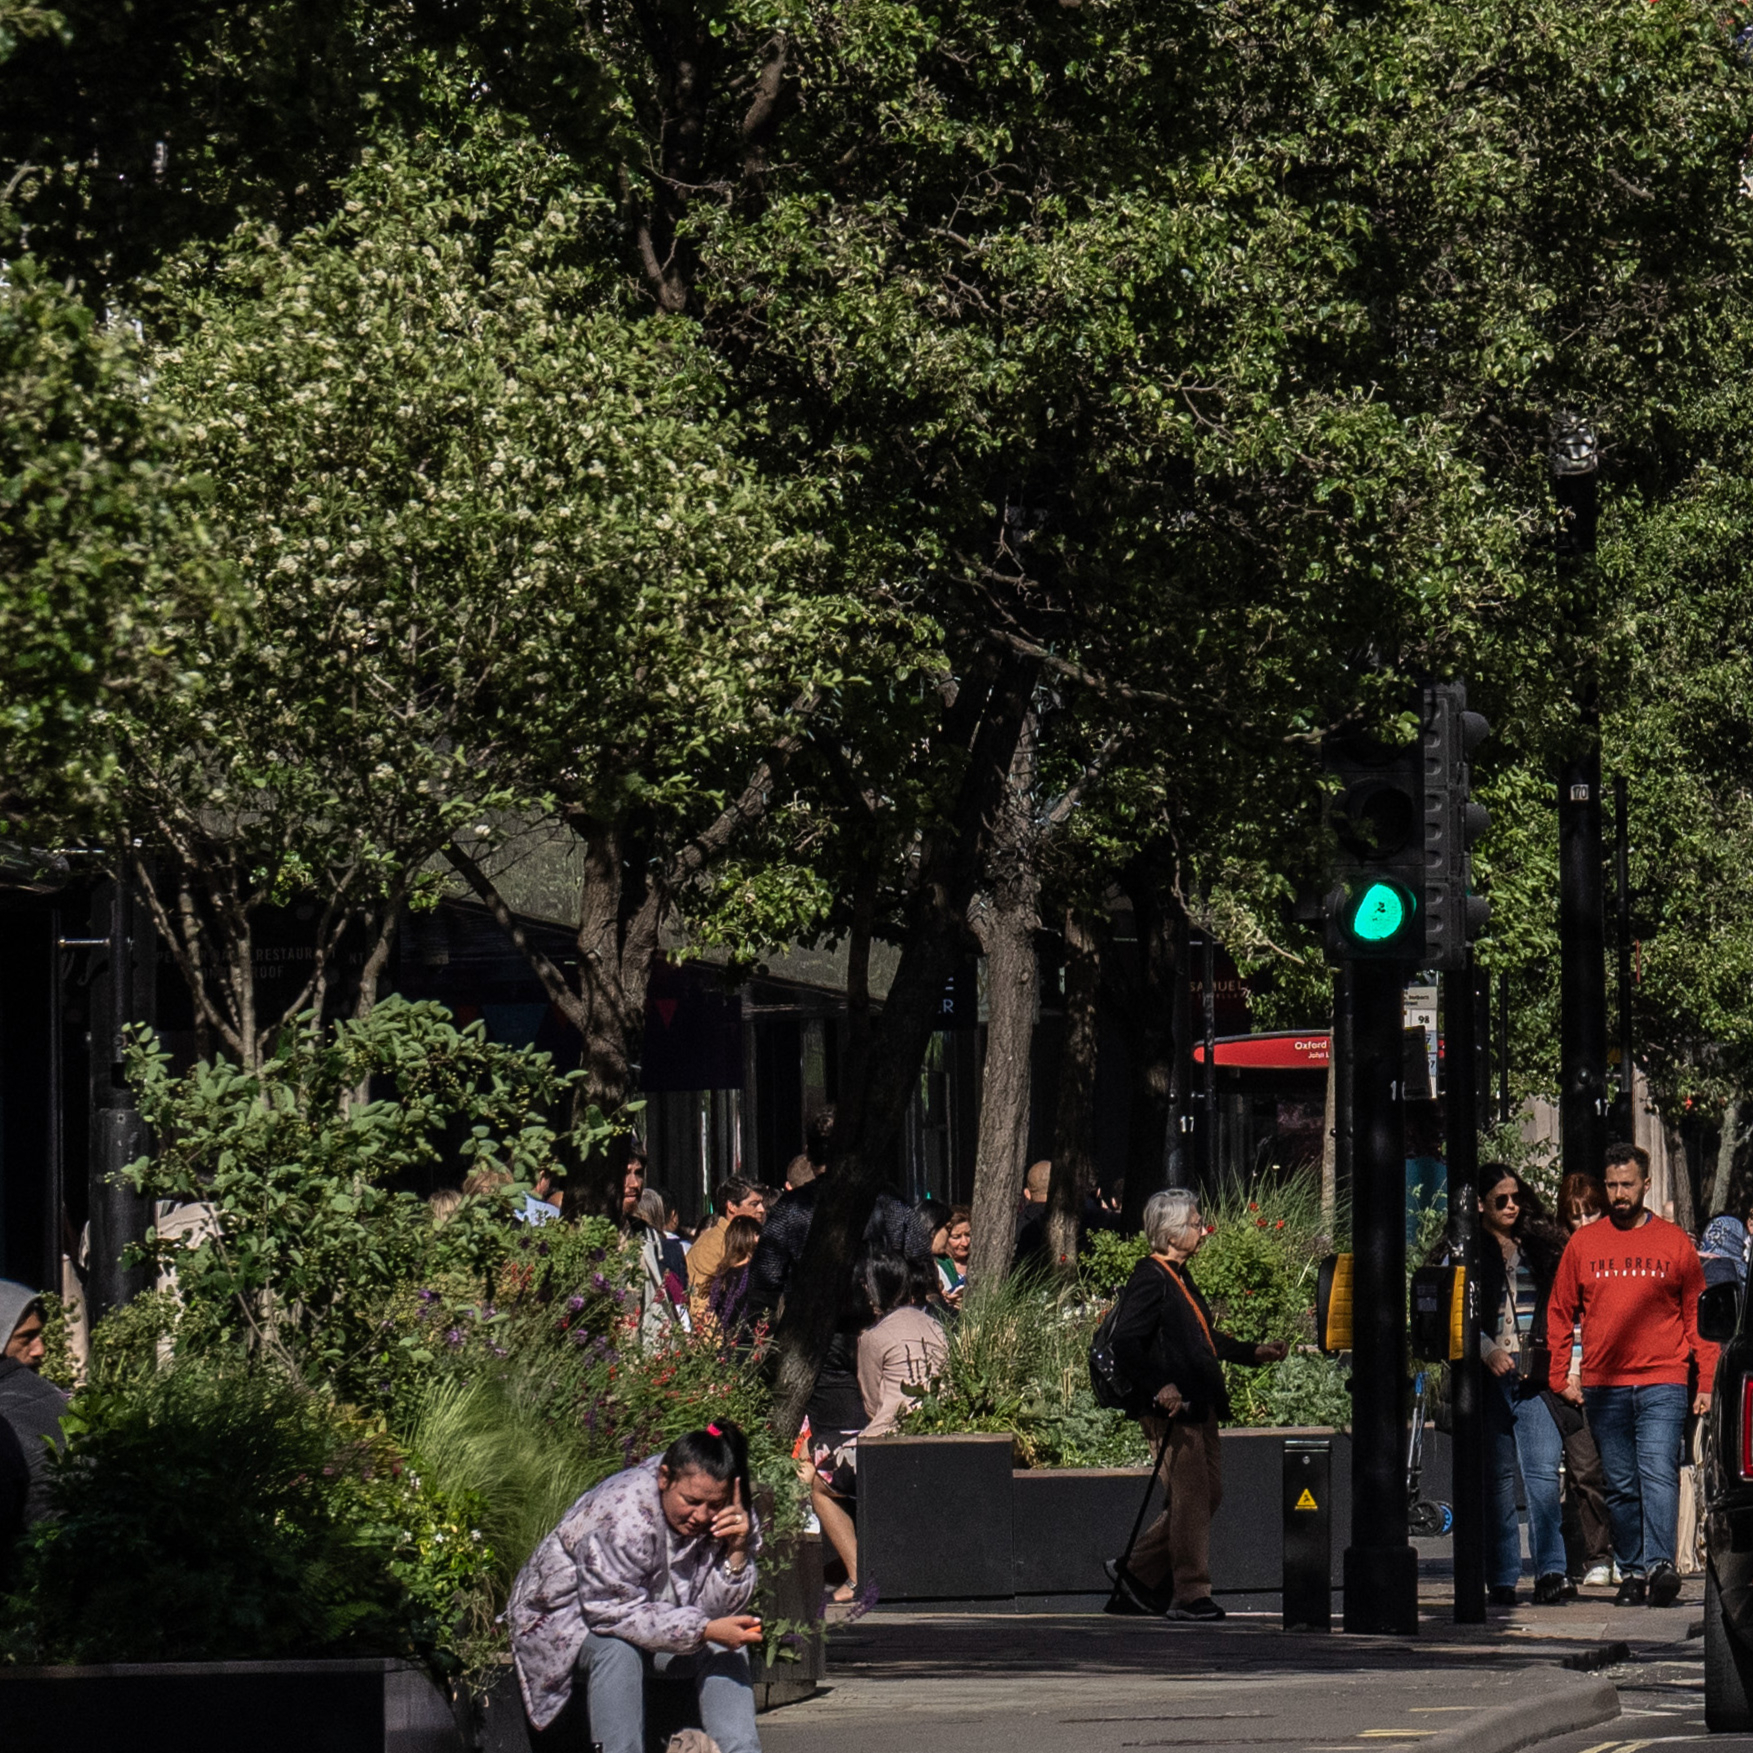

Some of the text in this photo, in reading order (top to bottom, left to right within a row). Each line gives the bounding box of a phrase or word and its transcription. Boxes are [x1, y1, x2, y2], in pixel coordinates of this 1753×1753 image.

[256, 947, 337, 962] RESTAURT
[1418, 1015, 1430, 1024] 98
[1294, 1040, 1327, 1050] Oxford
[1590, 1257, 1671, 1273] THE GREAT
